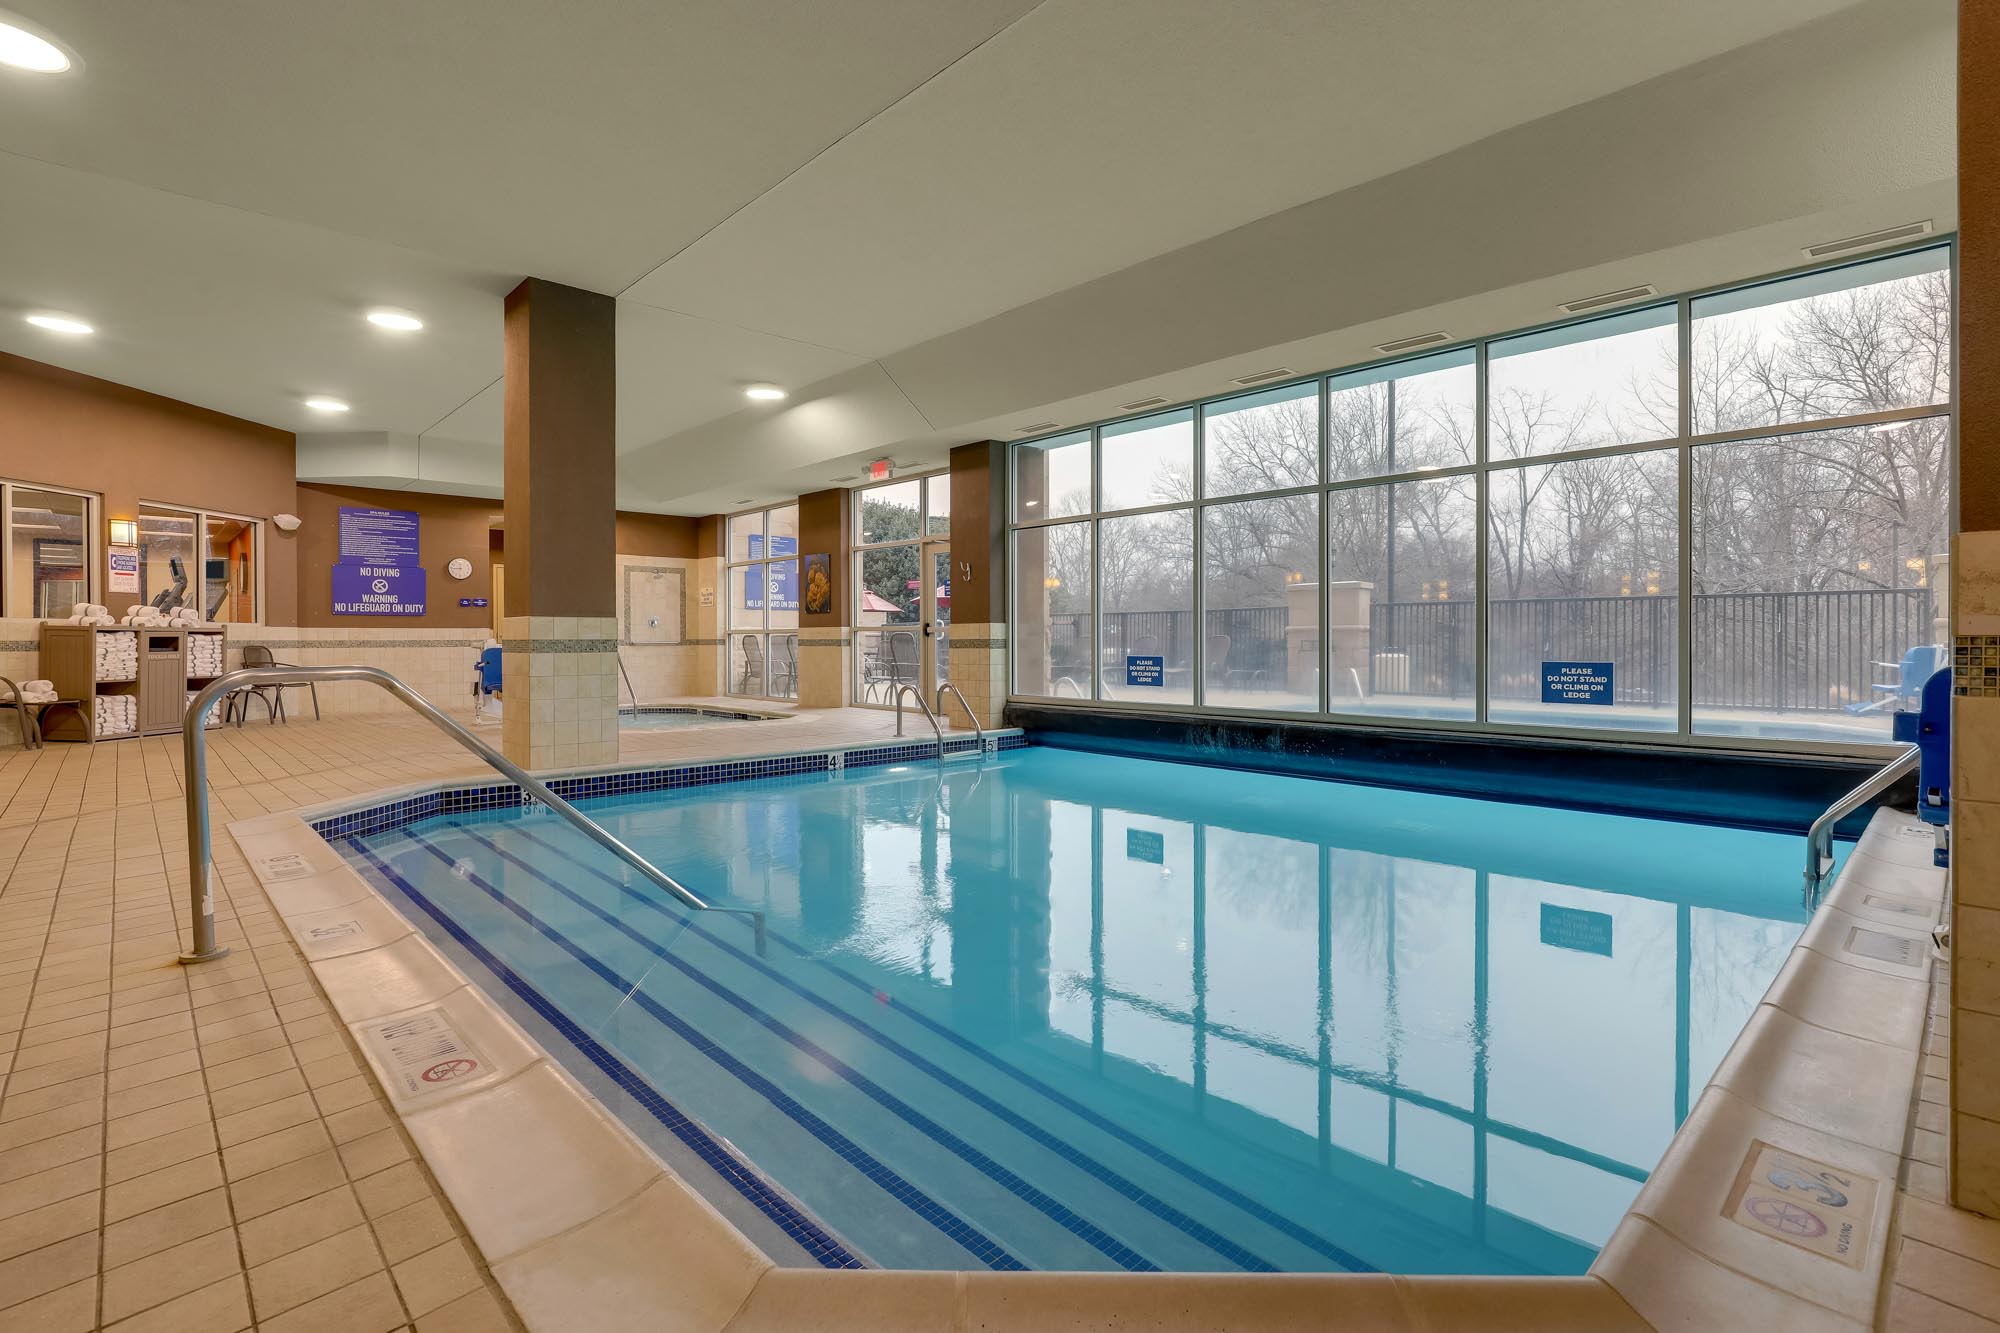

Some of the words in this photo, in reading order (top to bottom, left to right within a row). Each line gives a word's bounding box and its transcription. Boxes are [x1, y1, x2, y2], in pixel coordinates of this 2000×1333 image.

[360, 567, 371, 576] NO
[373, 568, 400, 577] DIVING
[362, 594, 398, 603] WARNING
[334, 603, 346, 612] NO
[348, 603, 391, 612] LIFEGUARD
[392, 604, 403, 612] ON
[404, 604, 424, 613] DUTY
[1839, 1222, 1853, 1245] DIVING
